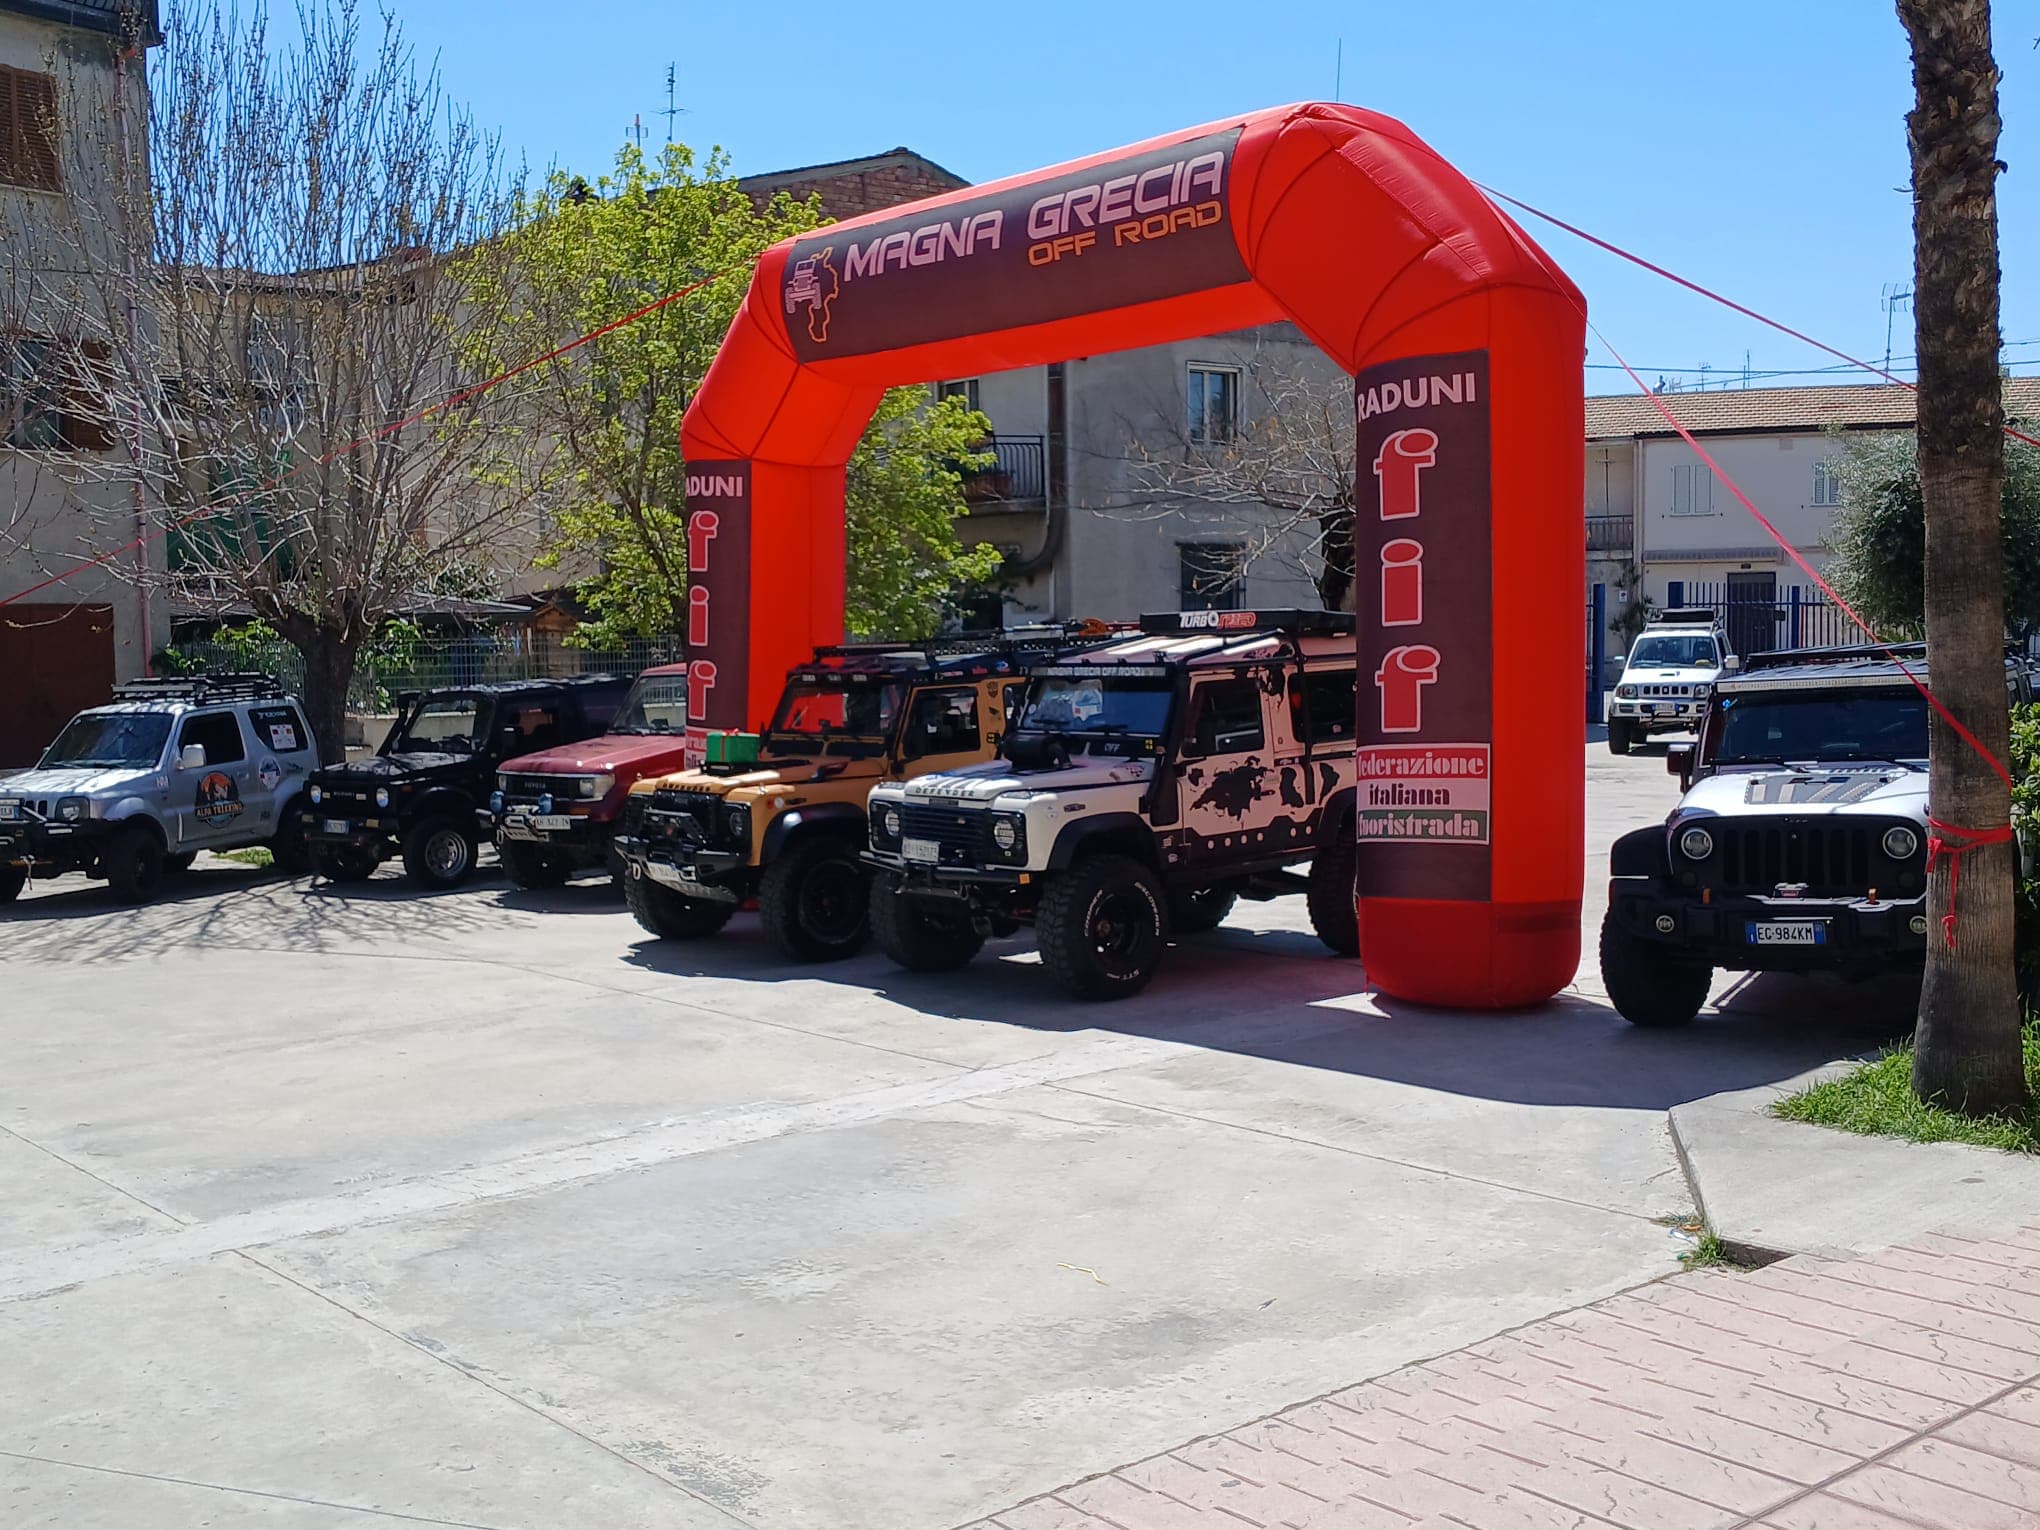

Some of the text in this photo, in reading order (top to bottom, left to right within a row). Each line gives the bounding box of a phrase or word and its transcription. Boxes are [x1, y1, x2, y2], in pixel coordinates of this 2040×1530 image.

[843, 151, 1227, 282] MAGNA GRECIA
[1027, 200, 1223, 267] OFF ROAD
[1357, 372, 1477, 423] RADUNI
[915, 787, 975, 797] DEFENDER
[1368, 783, 1450, 806] italiana
